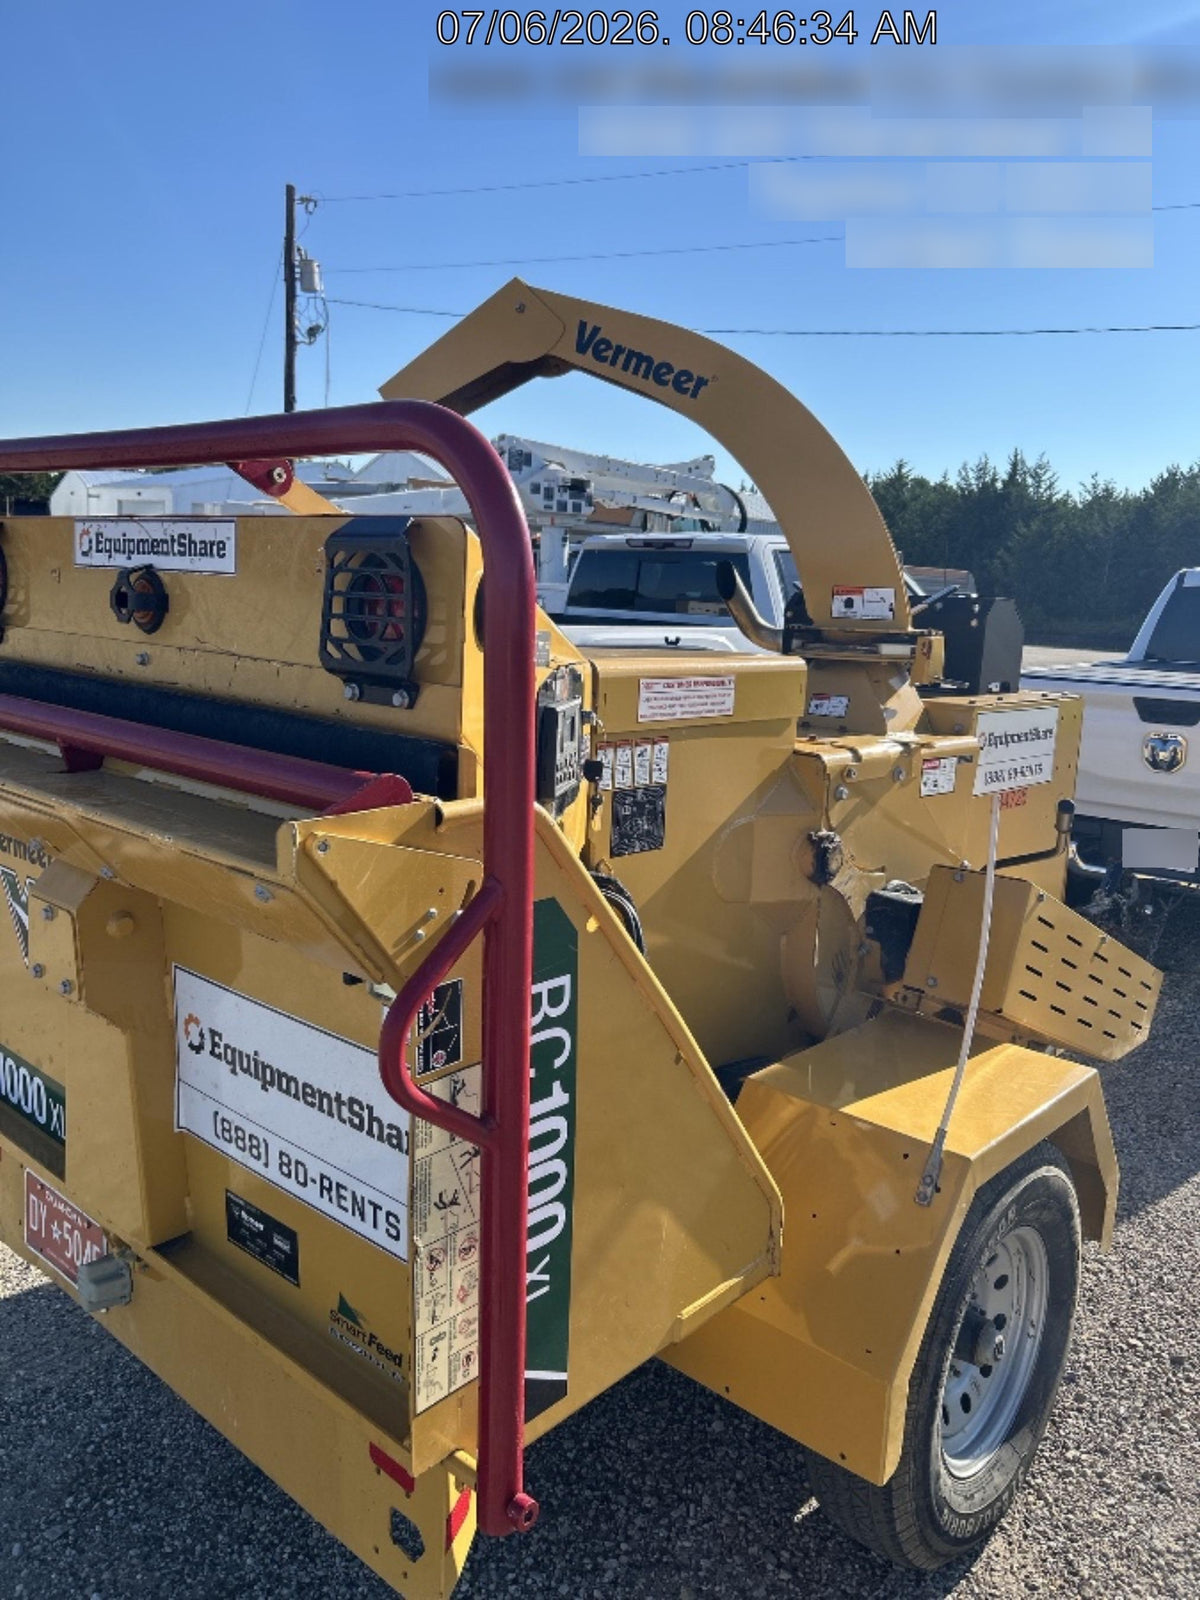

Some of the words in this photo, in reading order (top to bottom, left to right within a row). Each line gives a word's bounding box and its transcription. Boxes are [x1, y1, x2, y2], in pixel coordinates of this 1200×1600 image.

[575, 319, 709, 399] Vermeer
[94, 532, 227, 560] EquipmentShare
[213, 1110, 270, 1169] (888)
[278, 1149, 401, 1243] 80-RENTS
